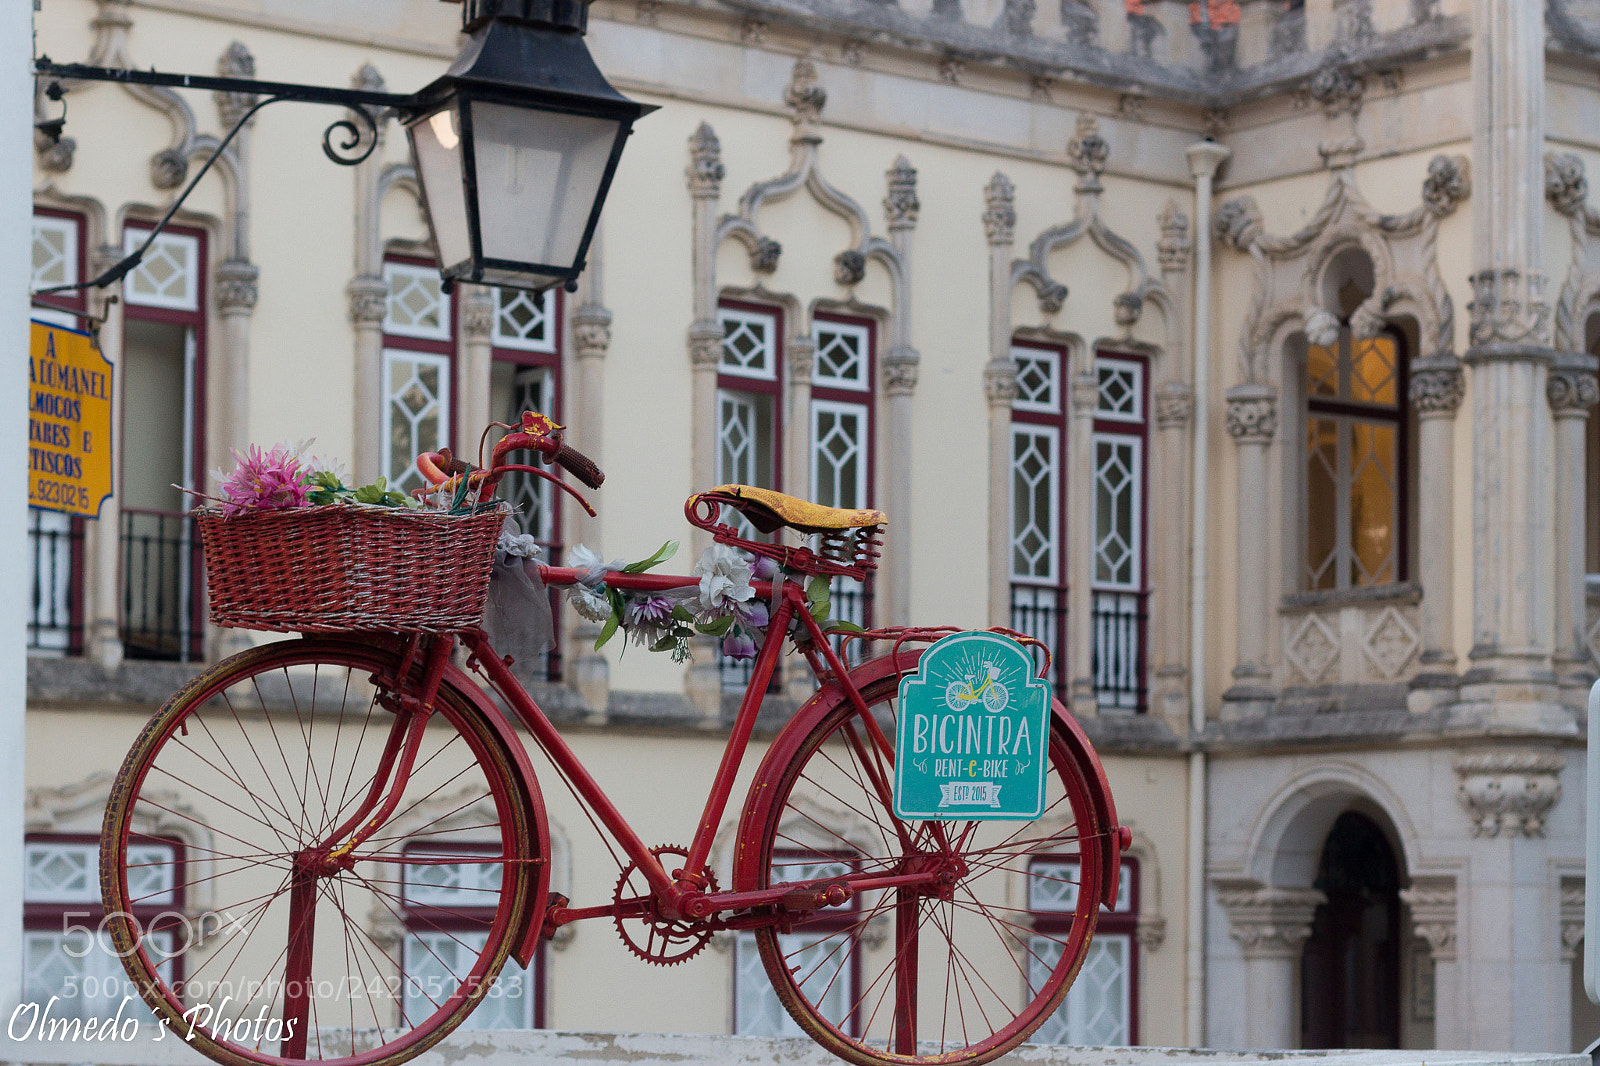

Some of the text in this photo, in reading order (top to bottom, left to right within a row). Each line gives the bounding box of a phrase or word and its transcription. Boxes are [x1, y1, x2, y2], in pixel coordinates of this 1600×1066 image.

[46, 331, 56, 359] A
[913, 713, 1032, 756] BICINTRA
[971, 785, 987, 801] 2015
